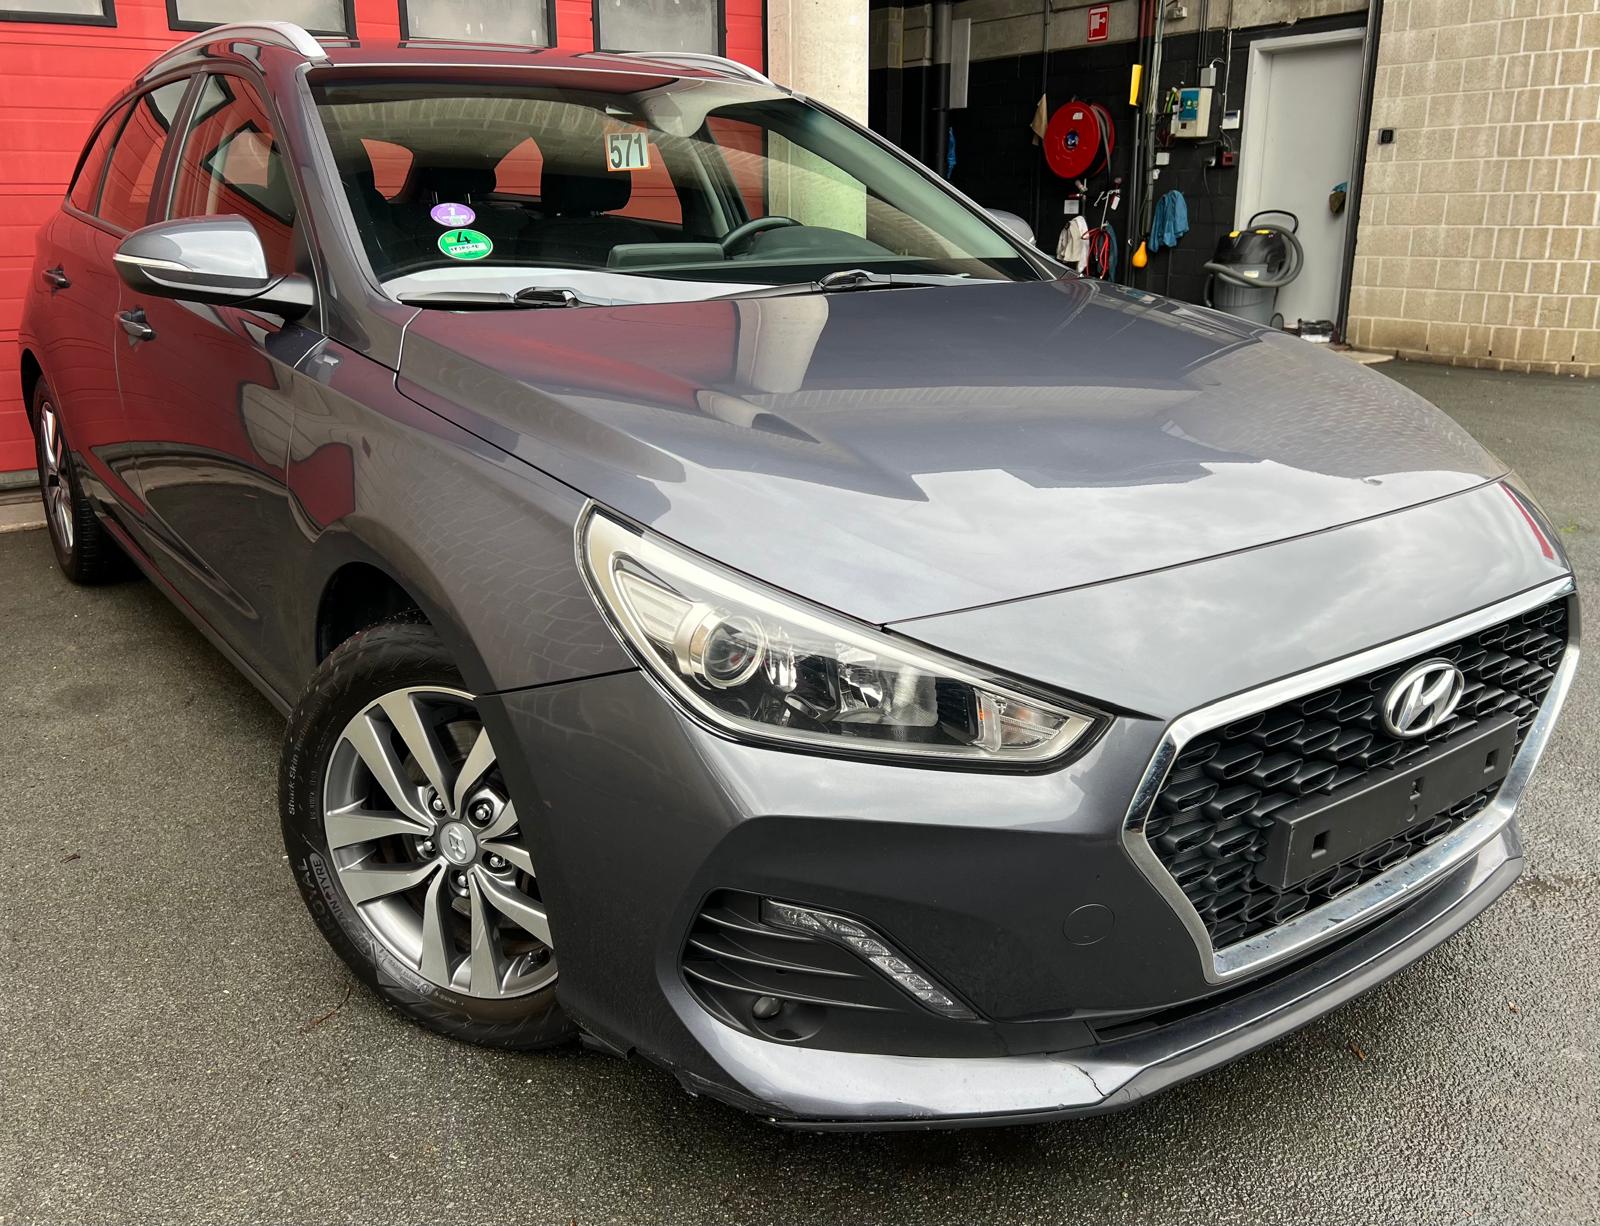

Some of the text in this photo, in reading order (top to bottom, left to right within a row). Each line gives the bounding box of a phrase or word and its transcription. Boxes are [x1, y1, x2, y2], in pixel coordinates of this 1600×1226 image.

[610, 133, 644, 168] 571
[457, 231, 471, 243] 4
[289, 753, 299, 780] Skin
[314, 859, 331, 892] TYRE
